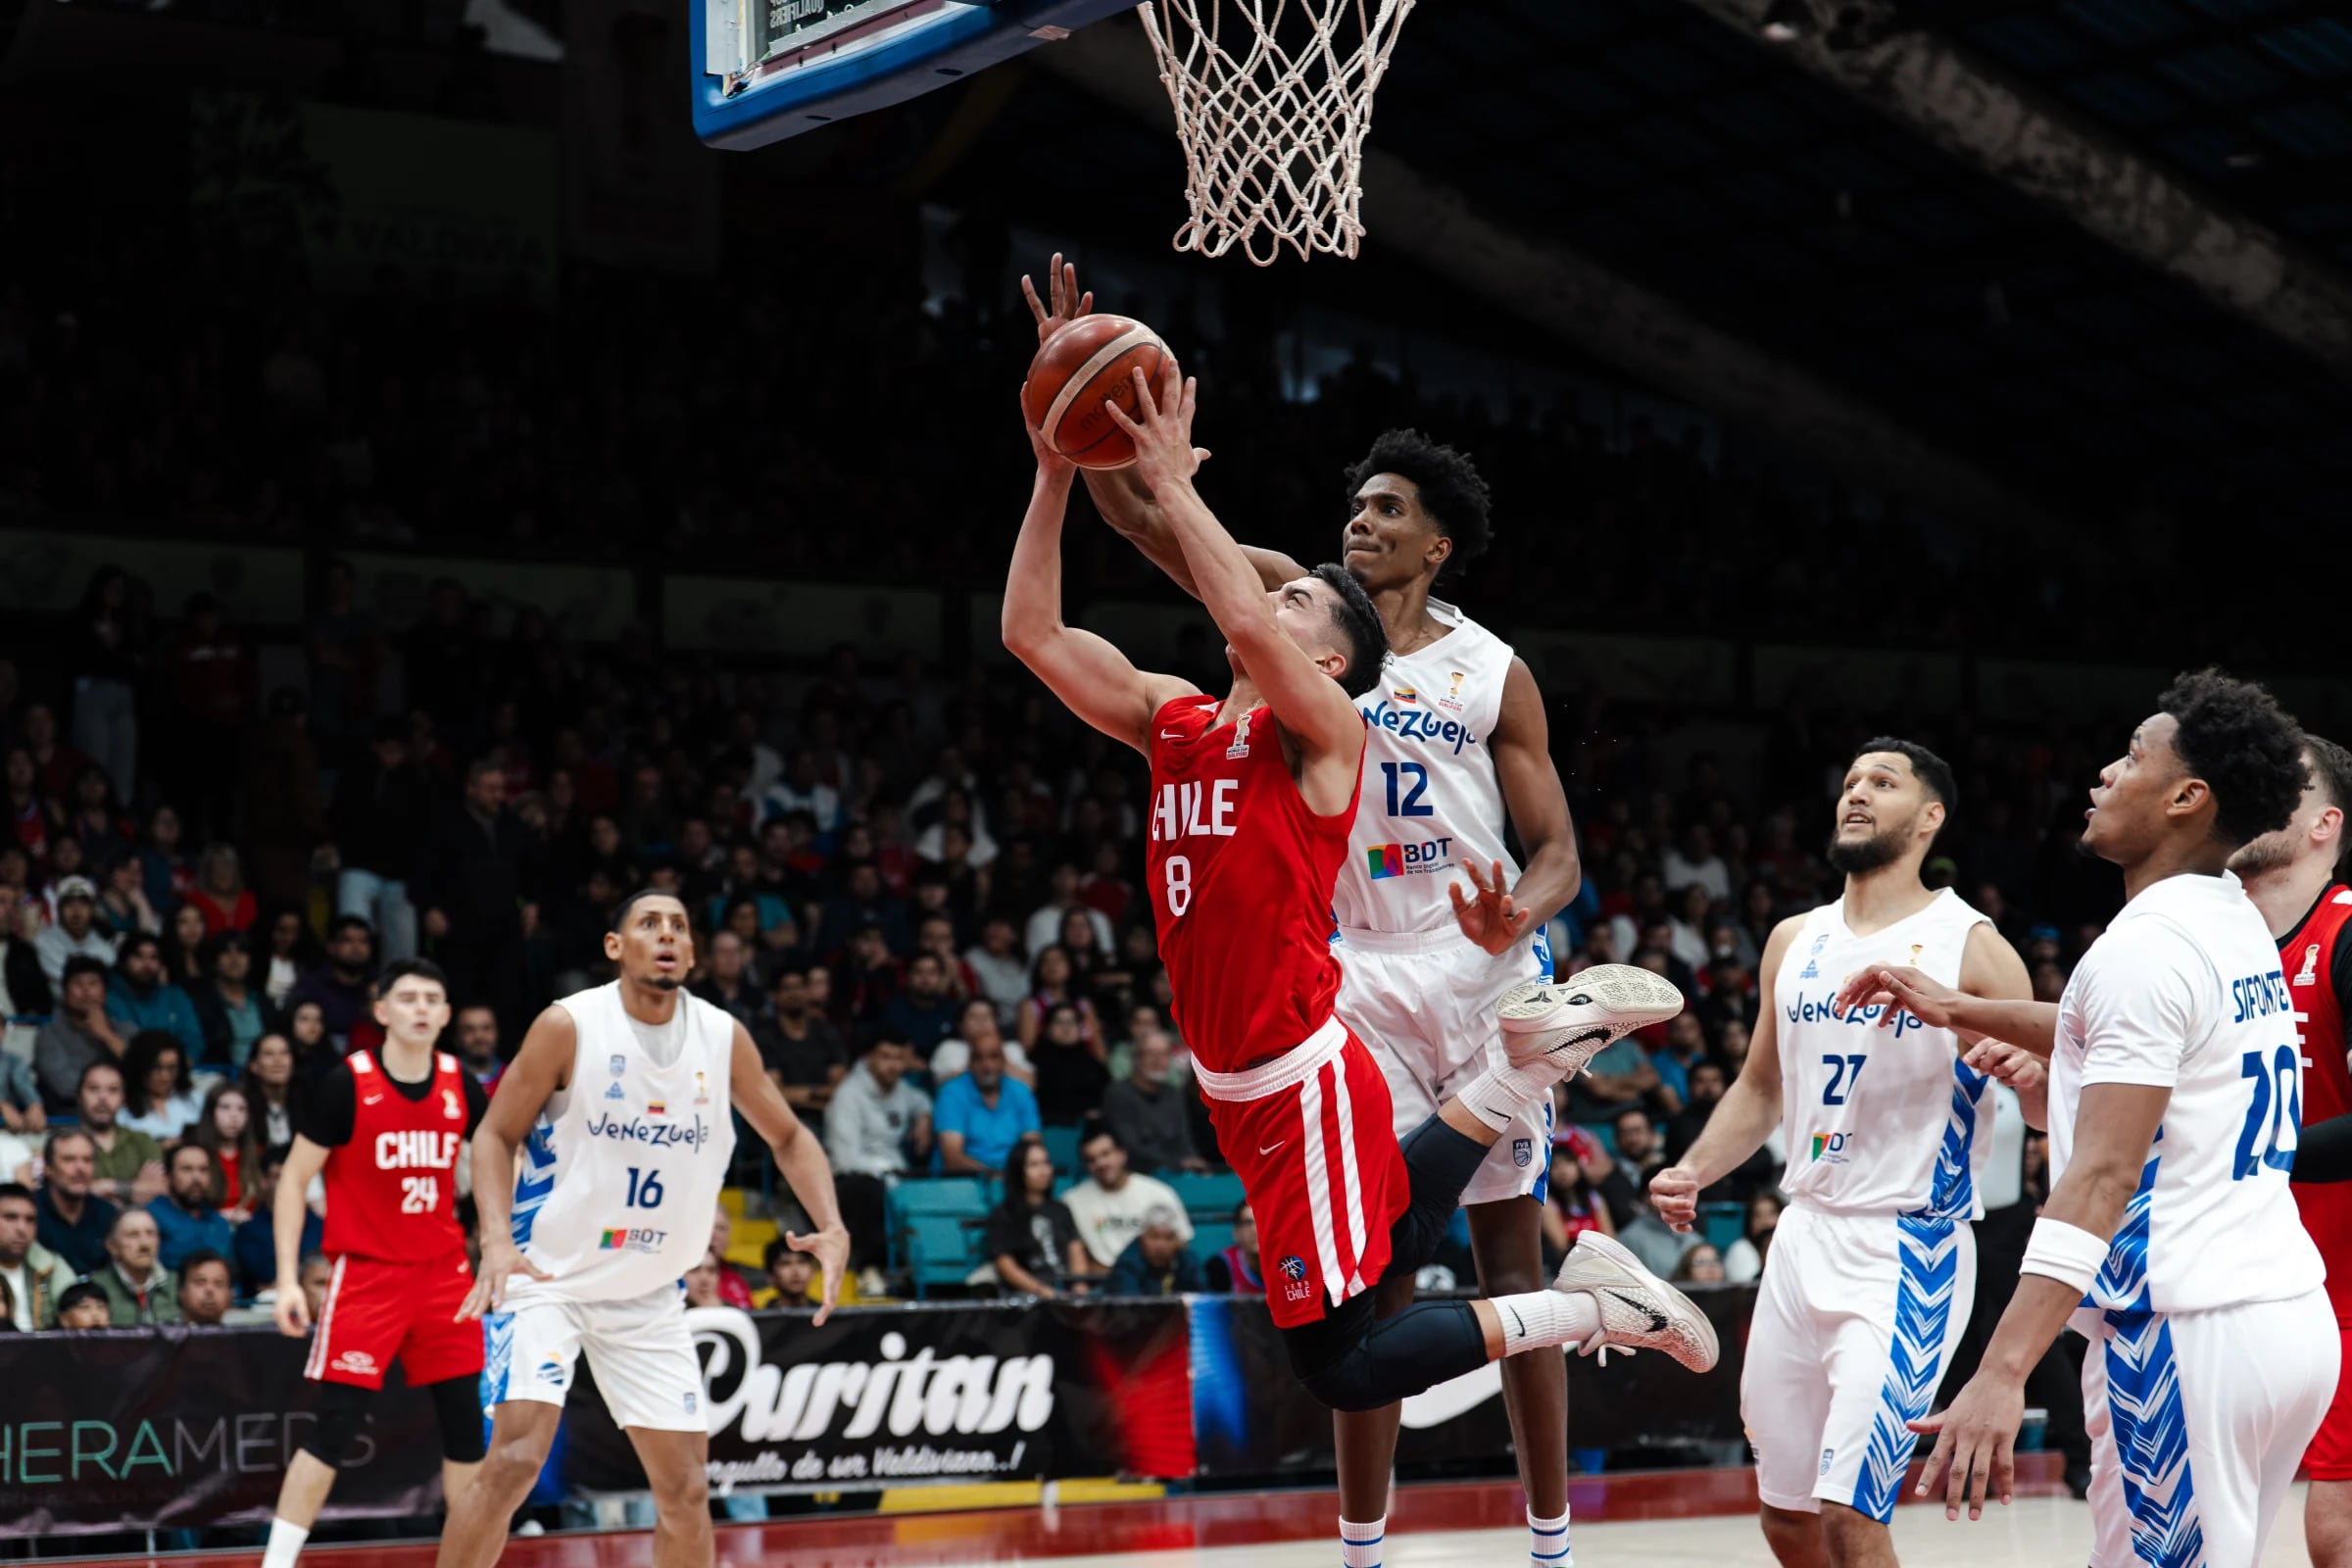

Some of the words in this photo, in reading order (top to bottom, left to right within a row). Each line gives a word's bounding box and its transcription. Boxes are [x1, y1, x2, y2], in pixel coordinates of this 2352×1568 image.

[1152, 778, 1239, 842] HILE
[1381, 761, 1434, 816] 12
[1403, 837, 1452, 863] BDT
[1165, 855, 1192, 917] 8
[1822, 1054, 1868, 1105] 27
[374, 1130, 461, 1170] CHILE
[401, 1176, 439, 1214] 24
[626, 1167, 664, 1209] 16
